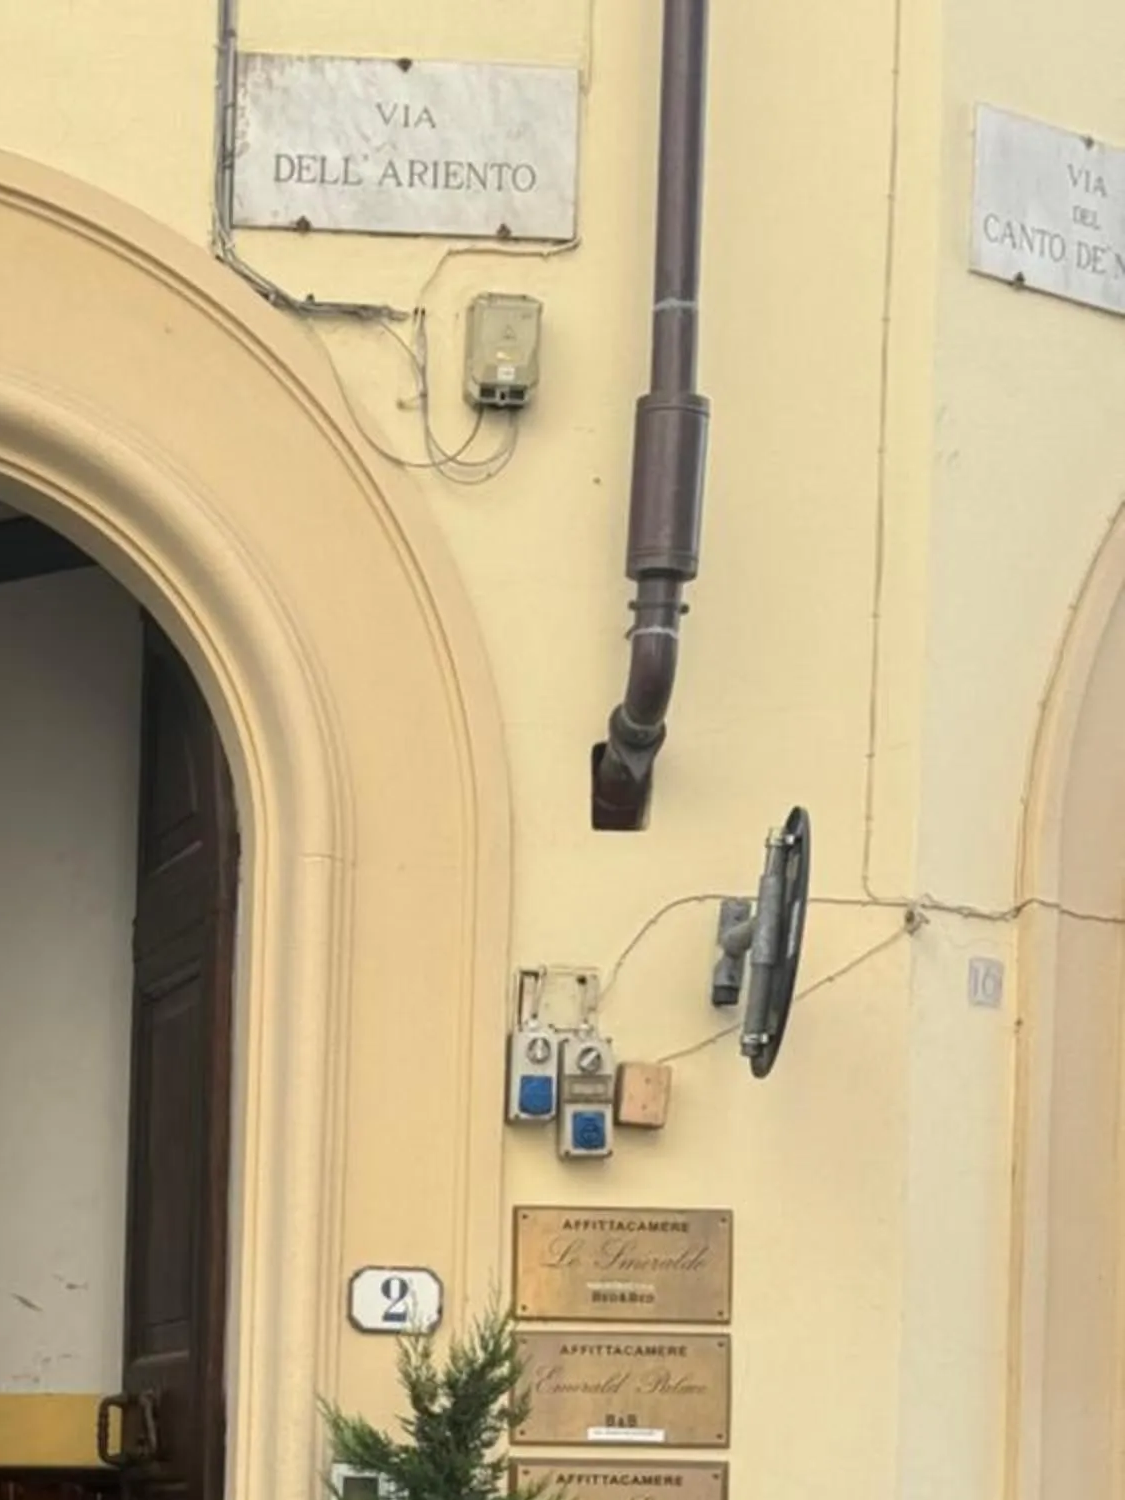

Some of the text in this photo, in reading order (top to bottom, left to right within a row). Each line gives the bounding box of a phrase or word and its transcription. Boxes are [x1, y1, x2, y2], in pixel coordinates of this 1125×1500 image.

[375, 101, 437, 129] VIA
[1067, 163, 1108, 199] VIA
[1072, 204, 1101, 231] DEL
[983, 212, 1066, 263] CANTO
[562, 1218, 690, 1234] AFFITTACAMERE
[381, 1277, 409, 1323] 2
[559, 1343, 687, 1357] AFFITTACAMERE
[555, 1473, 684, 1487] AFFITTACAMERE
